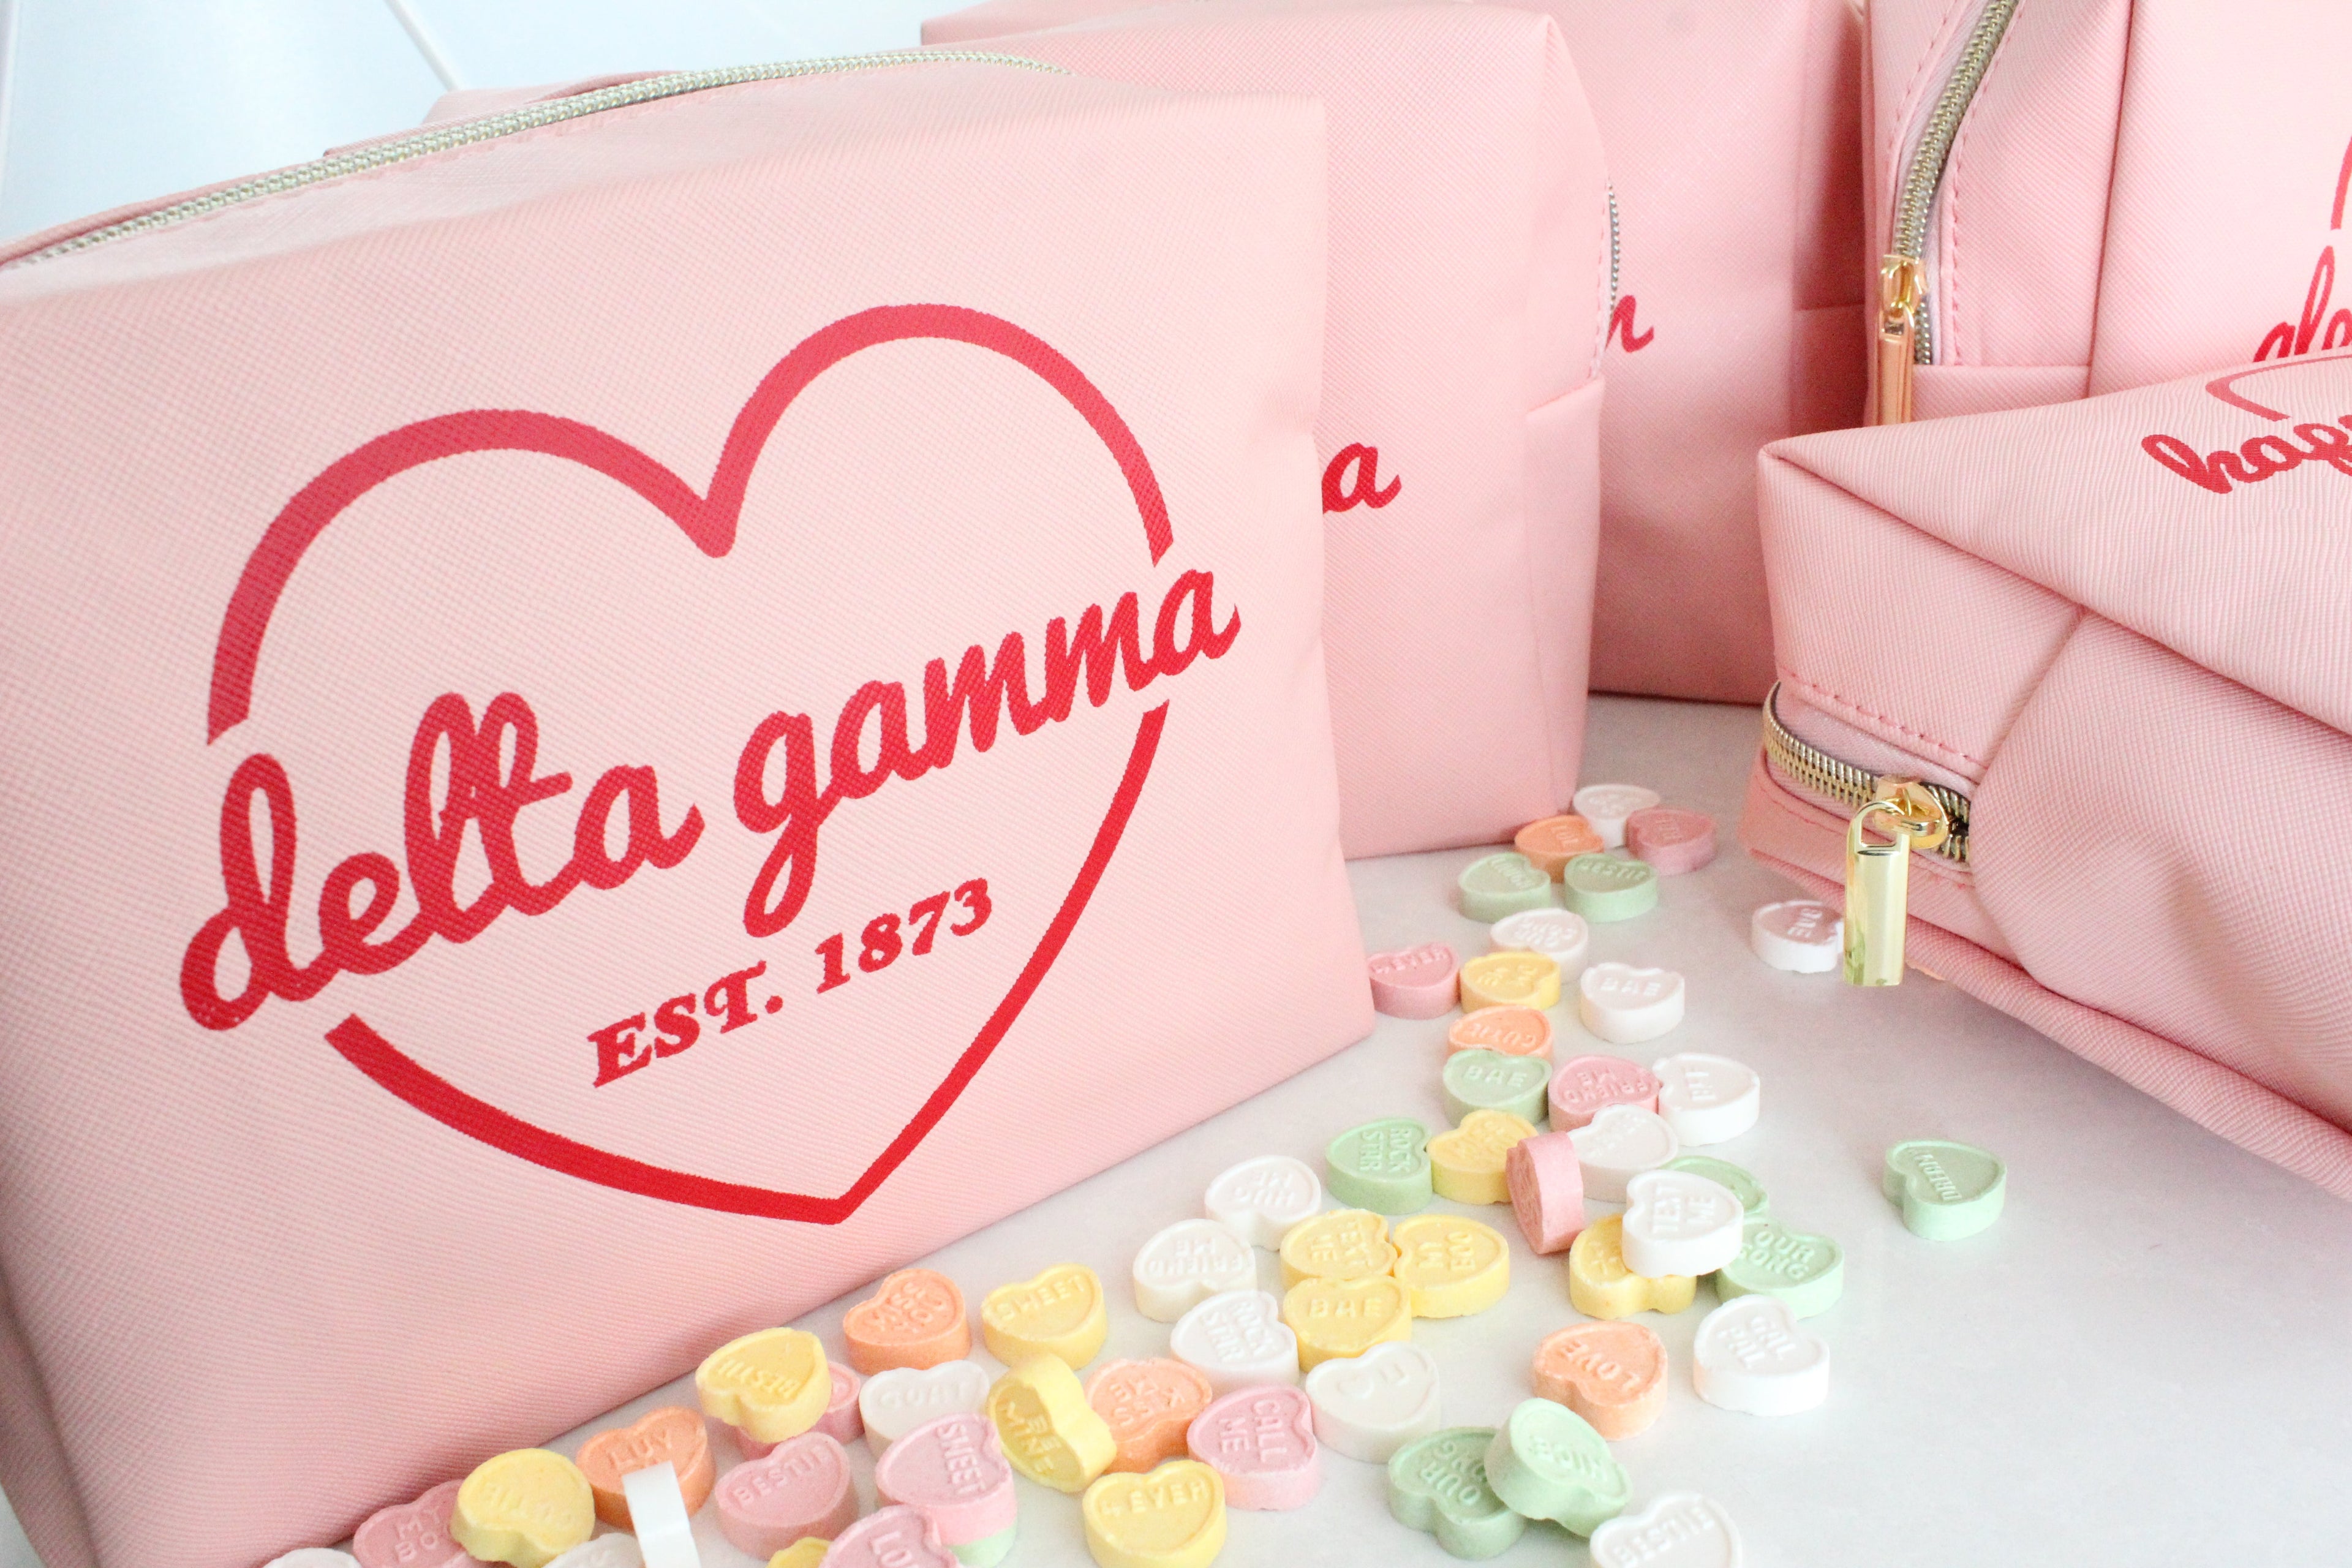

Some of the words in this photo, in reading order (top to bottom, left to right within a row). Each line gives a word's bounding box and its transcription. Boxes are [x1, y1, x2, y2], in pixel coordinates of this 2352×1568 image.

[180, 692, 705, 1030] delta
[734, 570, 1241, 938] gamma
[587, 961, 783, 1088] EST.
[816, 878, 992, 993] 1873
[1600, 977, 1661, 997] BAE
[1463, 1065, 1528, 1088] BAE
[1564, 1081, 1649, 1102] FRIEND
[1577, 1067, 1615, 1087] ME
[1360, 1131, 1384, 1172] STAR
[1390, 1128, 1412, 1172] ROCK
[1910, 1150, 1962, 1201] DREAM
[1653, 1185, 1681, 1234] TEXT
[1686, 1195, 1715, 1224] ME
[1148, 1253, 1246, 1276] FRIEND
[1175, 1238, 1216, 1256] ME
[1447, 1231, 1476, 1271] BOO
[1754, 1231, 1815, 1262] OUR
[997, 1275, 1084, 1321] SWEET
[1310, 1298, 1382, 1319] BAE
[1719, 1327, 1765, 1368] PAL
[1749, 1317, 1796, 1359] GAL
[717, 1359, 801, 1396] BESTIE
[1562, 1341, 1640, 1395] LOVE
[880, 1379, 968, 1408] GOAT
[1005, 1400, 1054, 1471] MINE
[1028, 1415, 1062, 1450] BE
[1219, 1416, 1250, 1453] ME
[1254, 1400, 1286, 1463] CALL
[733, 1442, 831, 1507] BESTIE
[937, 1423, 986, 1493] SWEET
[1420, 1461, 1479, 1505] OUR
[394, 1531, 439, 1562] BO
[1613, 1506, 1715, 1564] BESTIE
